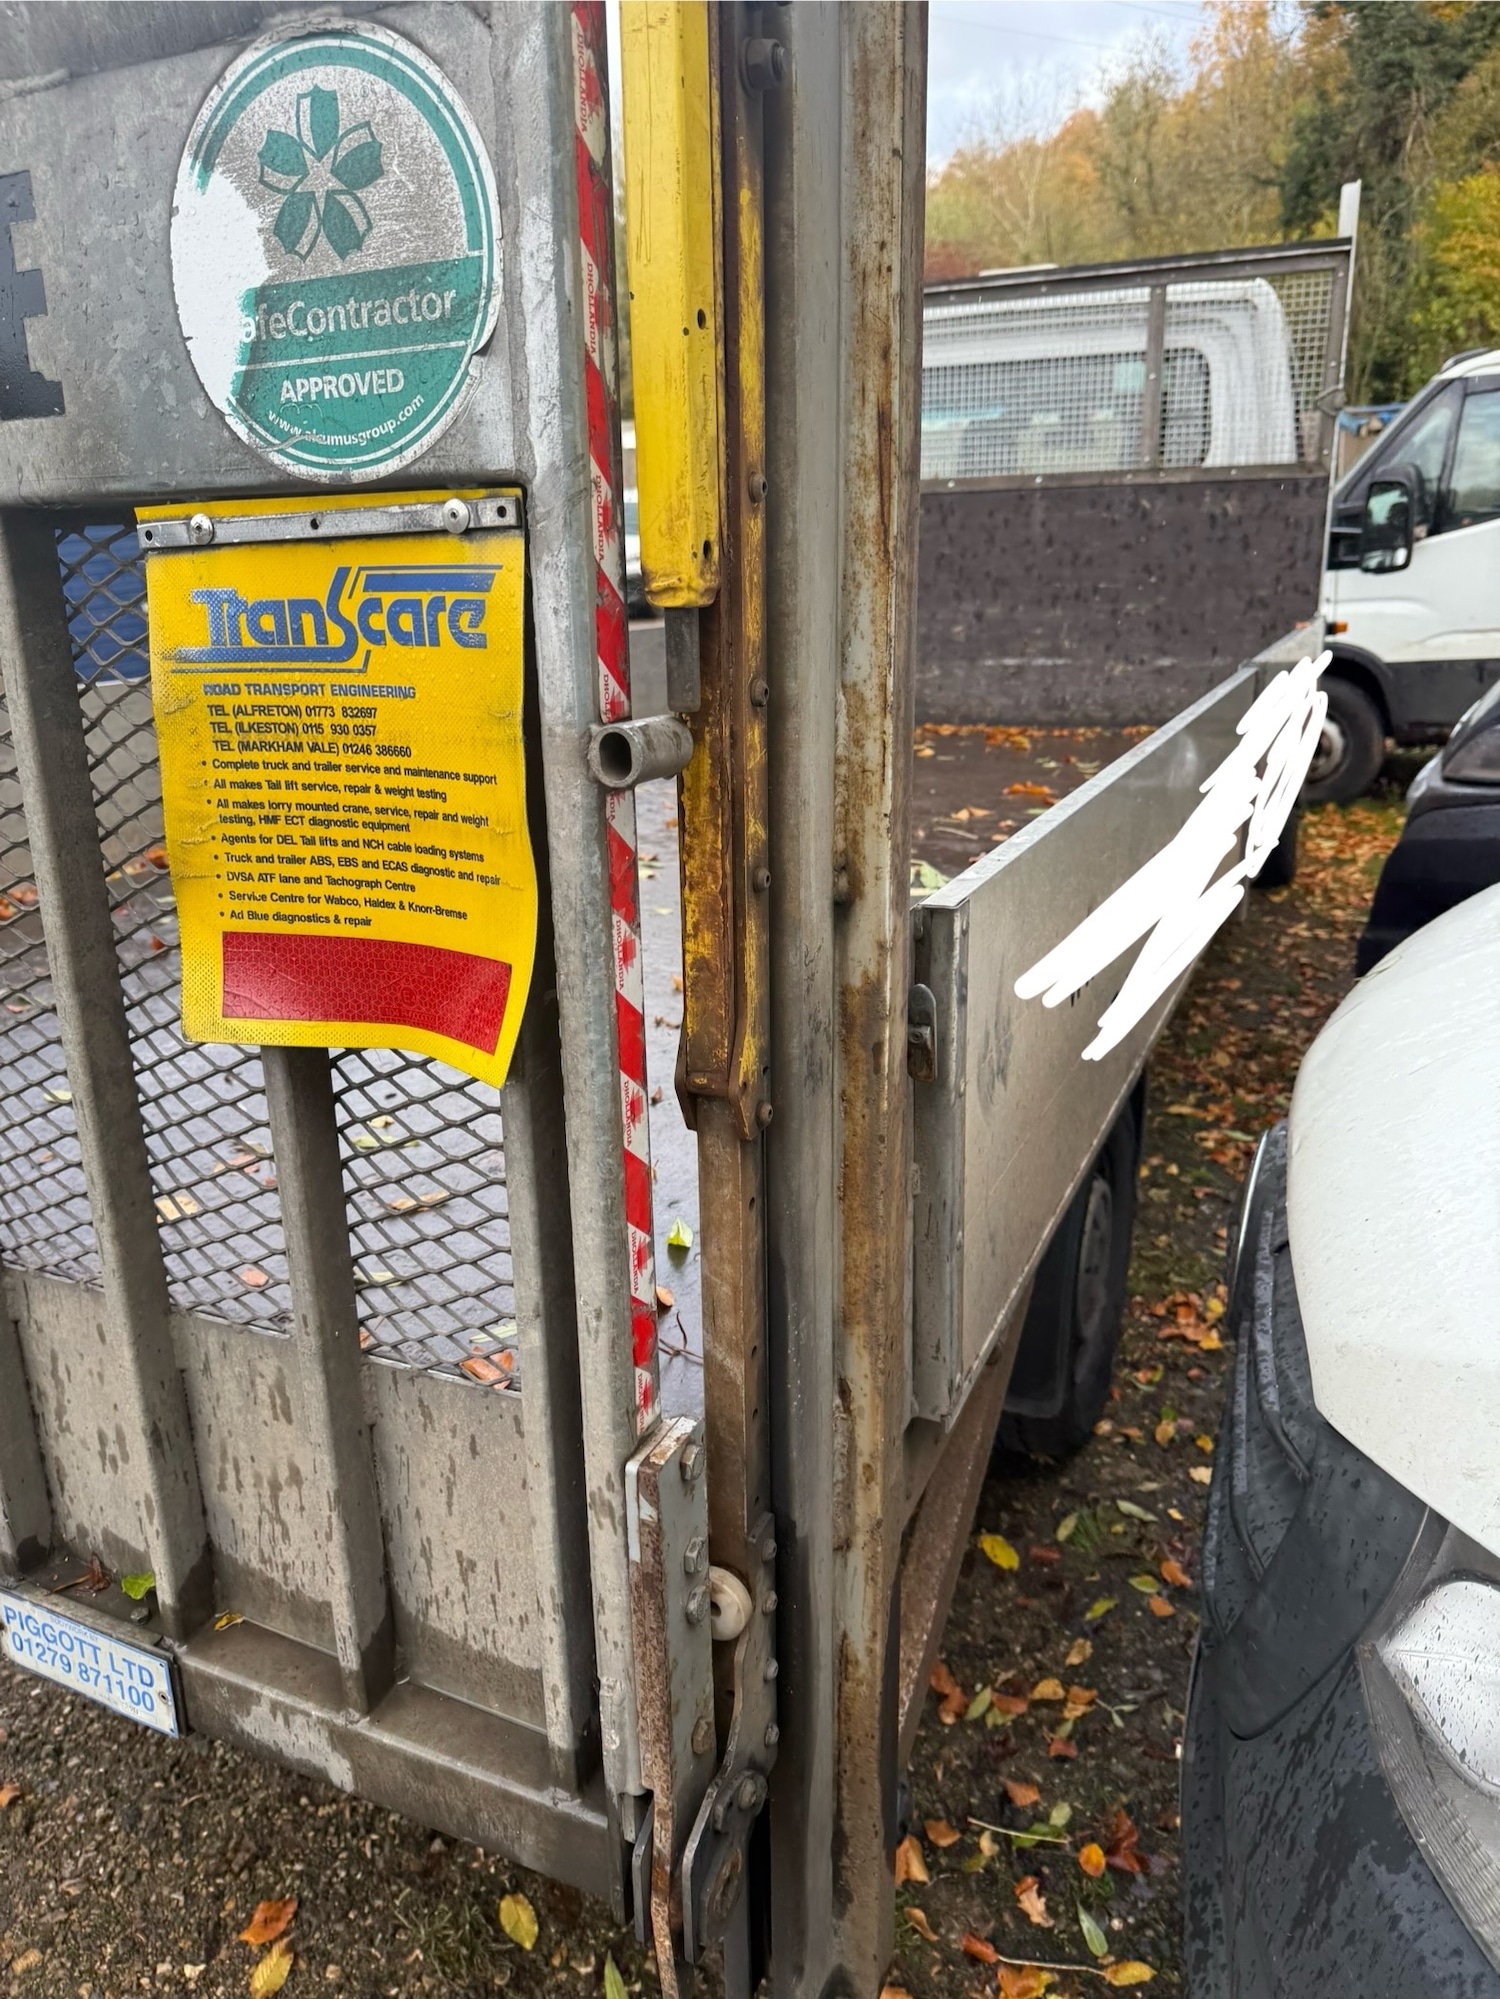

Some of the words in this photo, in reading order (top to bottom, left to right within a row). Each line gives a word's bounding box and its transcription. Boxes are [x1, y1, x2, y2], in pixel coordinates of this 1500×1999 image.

[578, 33, 588, 132] DHOLLANDIA
[239, 288, 456, 343] afeContractor
[587, 263, 597, 354] DHOLLANDIA
[279, 368, 405, 404] APPROVED
[202, 683, 241, 696] ROAD
[244, 683, 325, 696] TRANSPORT
[330, 684, 416, 699] ENGINEERING
[207, 705, 229, 717] TEL
[232, 705, 302, 719] (ALFRETON)
[305, 707, 335, 718] 01773
[342, 707, 377, 719] 832697
[210, 722, 232, 734] TEL
[235, 722, 299, 737] (ILKESTON)
[302, 724, 324, 735] 0115
[331, 724, 349, 736] 930
[353, 725, 376, 737] 0357
[213, 740, 235, 752] TEL
[238, 740, 304, 754] (MARKHAM
[306, 742, 339, 756] VALE)
[342, 744, 372, 756] 01246
[375, 745, 412, 758] 386660
[212, 759, 259, 771] Complete
[262, 760, 288, 771] truck
[292, 760, 310, 771] and
[314, 761, 342, 772] trailer
[345, 763, 380, 774] service
[384, 765, 401, 776] and
[404, 767, 461, 781] maintenance
[463, 773, 497, 786] support
[213, 779, 226, 789] All
[229, 779, 262, 790] makes
[265, 780, 281, 791] Tail
[284, 780, 298, 791] lift
[301, 781, 341, 794] service,
[343, 783, 371, 795] repair
[374, 784, 382, 794] &
[384, 786, 414, 799] weight
[416, 787, 447, 802] testing
[216, 799, 229, 809] All
[232, 799, 265, 810] makes
[268, 800, 292, 812] lorry
[295, 801, 339, 812] mounted
[342, 803, 372, 816] crane,
[374, 805, 411, 819] service,
[414, 809, 439, 821] repair
[442, 812, 459, 822] and
[461, 814, 489, 828] weight
[219, 814, 256, 826] testing,
[258, 814, 281, 825] HMF
[284, 815, 305, 825] ECT
[308, 816, 359, 829] diagnostic
[362, 819, 410, 833] equipment
[221, 833, 256, 846] Agents
[259, 834, 273, 844] for
[276, 834, 298, 845] DEL
[299, 835, 316, 846] Tail
[319, 836, 338, 847] lifts
[341, 837, 359, 848] and
[362, 839, 384, 850] NCH
[387, 842, 412, 853] cable
[414, 844, 447, 859] loading
[449, 848, 484, 862] systems
[224, 852, 253, 863] Truck
[255, 853, 274, 864] and
[277, 854, 306, 865] trailer
[309, 855, 335, 868] ABS,
[337, 856, 358, 868] EBS
[362, 859, 379, 870] and
[382, 860, 408, 872] ECAS
[410, 863, 456, 878] diagnostic
[457, 870, 474, 881] and
[476, 873, 501, 886] repair
[226, 871, 254, 882] DVSA
[257, 872, 276, 883] ATF
[279, 873, 301, 884] lane
[303, 874, 323, 885] and
[325, 875, 382, 891] Tachograph
[385, 879, 416, 892] Centre
[228, 890, 267, 902] Service
[270, 892, 305, 903] Centre
[307, 893, 322, 904] for
[324, 894, 361, 908] Wabco,
[364, 897, 396, 910] Haldex
[398, 900, 406, 911] &
[408, 902, 468, 920] Knorr-Bremse
[247, 910, 269, 921] Blue
[272, 911, 330, 924] diagnostics
[333, 914, 341, 924] &
[344, 915, 372, 928] repair
[3, 1605, 102, 1666] PIGGOTT
[108, 1651, 156, 1689] LTD
[11, 1631, 72, 1675] 01279
[77, 1662, 156, 1713] 871100
